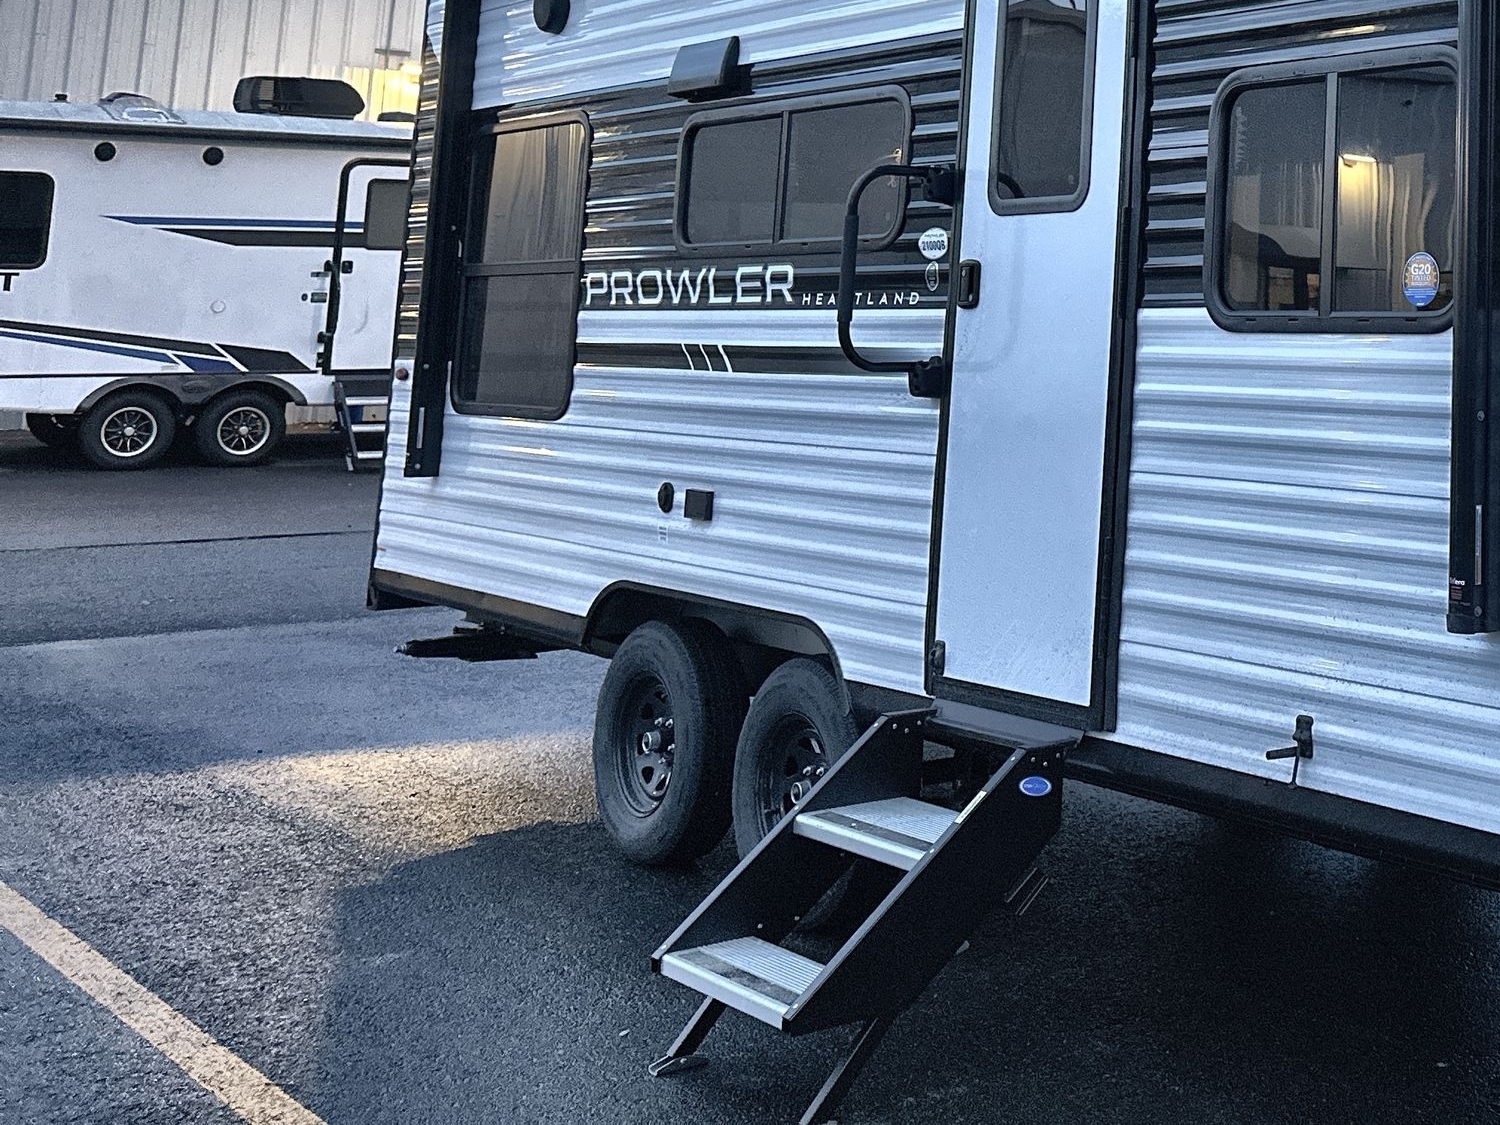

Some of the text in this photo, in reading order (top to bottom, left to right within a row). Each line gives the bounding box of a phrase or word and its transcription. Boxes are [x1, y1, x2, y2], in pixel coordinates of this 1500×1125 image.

[1411, 263, 1431, 276] G20
[585, 263, 795, 306] PROWLER
[801, 291, 920, 306] HEATLAND
